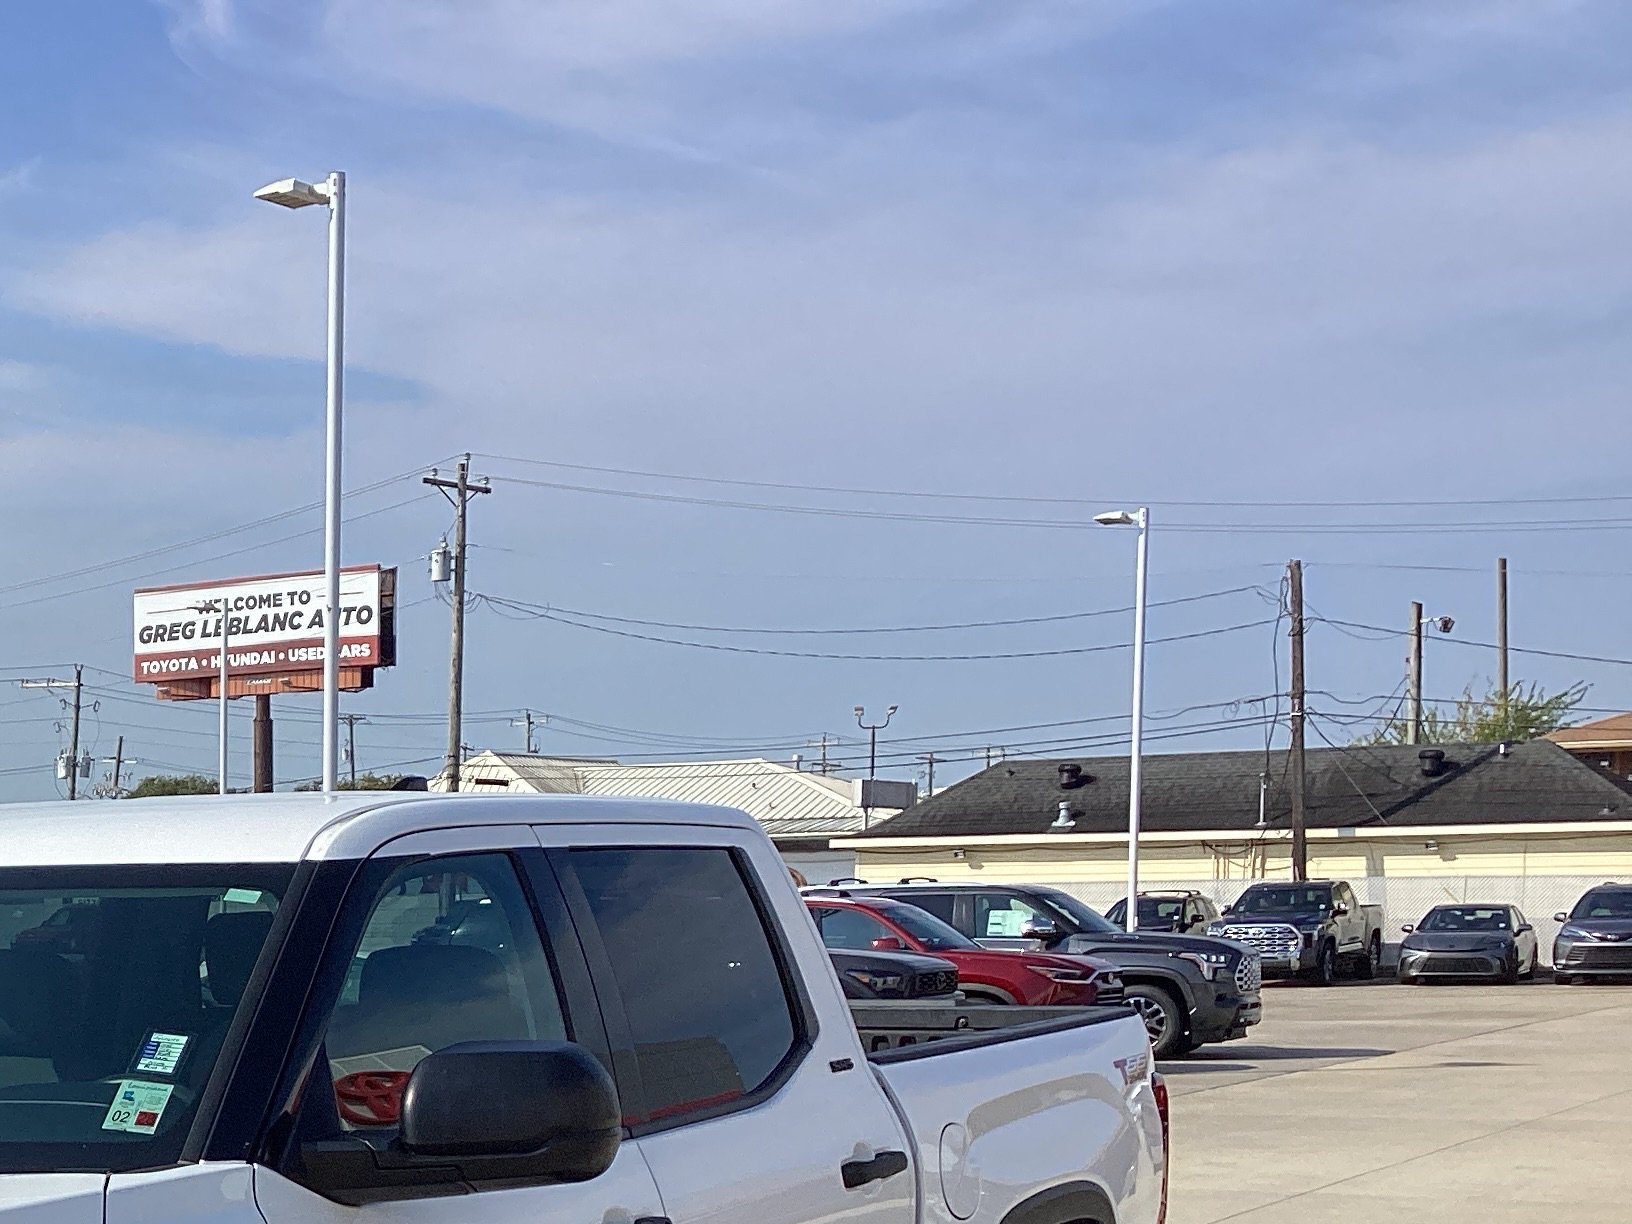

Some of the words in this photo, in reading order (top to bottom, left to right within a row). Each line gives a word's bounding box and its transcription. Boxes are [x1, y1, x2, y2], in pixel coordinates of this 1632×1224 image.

[287, 590, 311, 605] TO
[139, 621, 196, 644] GREG
[201, 610, 304, 639] LEBLANC
[307, 605, 373, 630] ATO
[141, 659, 198, 675] TOYOTA
[288, 647, 325, 662] USED
[337, 643, 371, 658] ARS
[111, 1110, 131, 1123] 02
